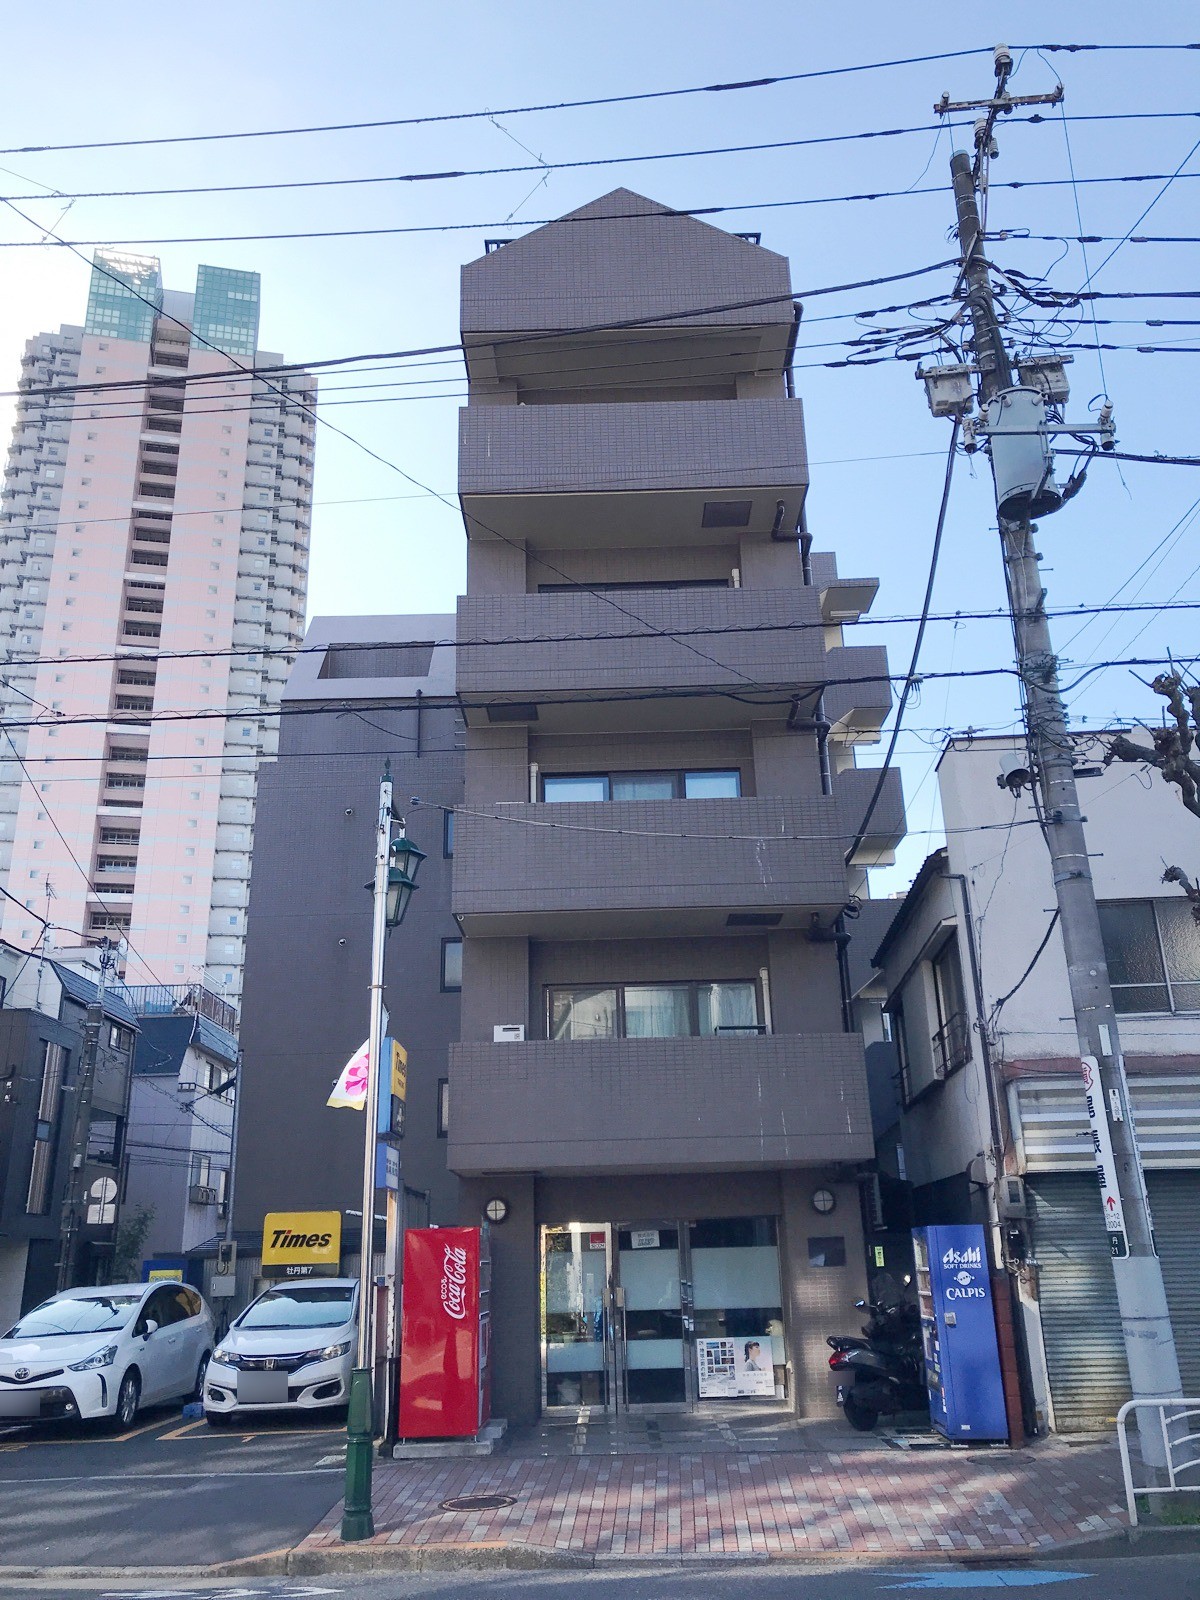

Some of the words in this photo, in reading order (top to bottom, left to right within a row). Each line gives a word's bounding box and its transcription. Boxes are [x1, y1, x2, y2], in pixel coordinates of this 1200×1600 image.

[270, 1229, 332, 1248] Times
[942, 1246, 981, 1264] Asahi
[286, 1266, 313, 1275] 牡丹第7
[443, 1243, 467, 1319] Coca-Cola
[946, 1287, 985, 1300] CALPIS
